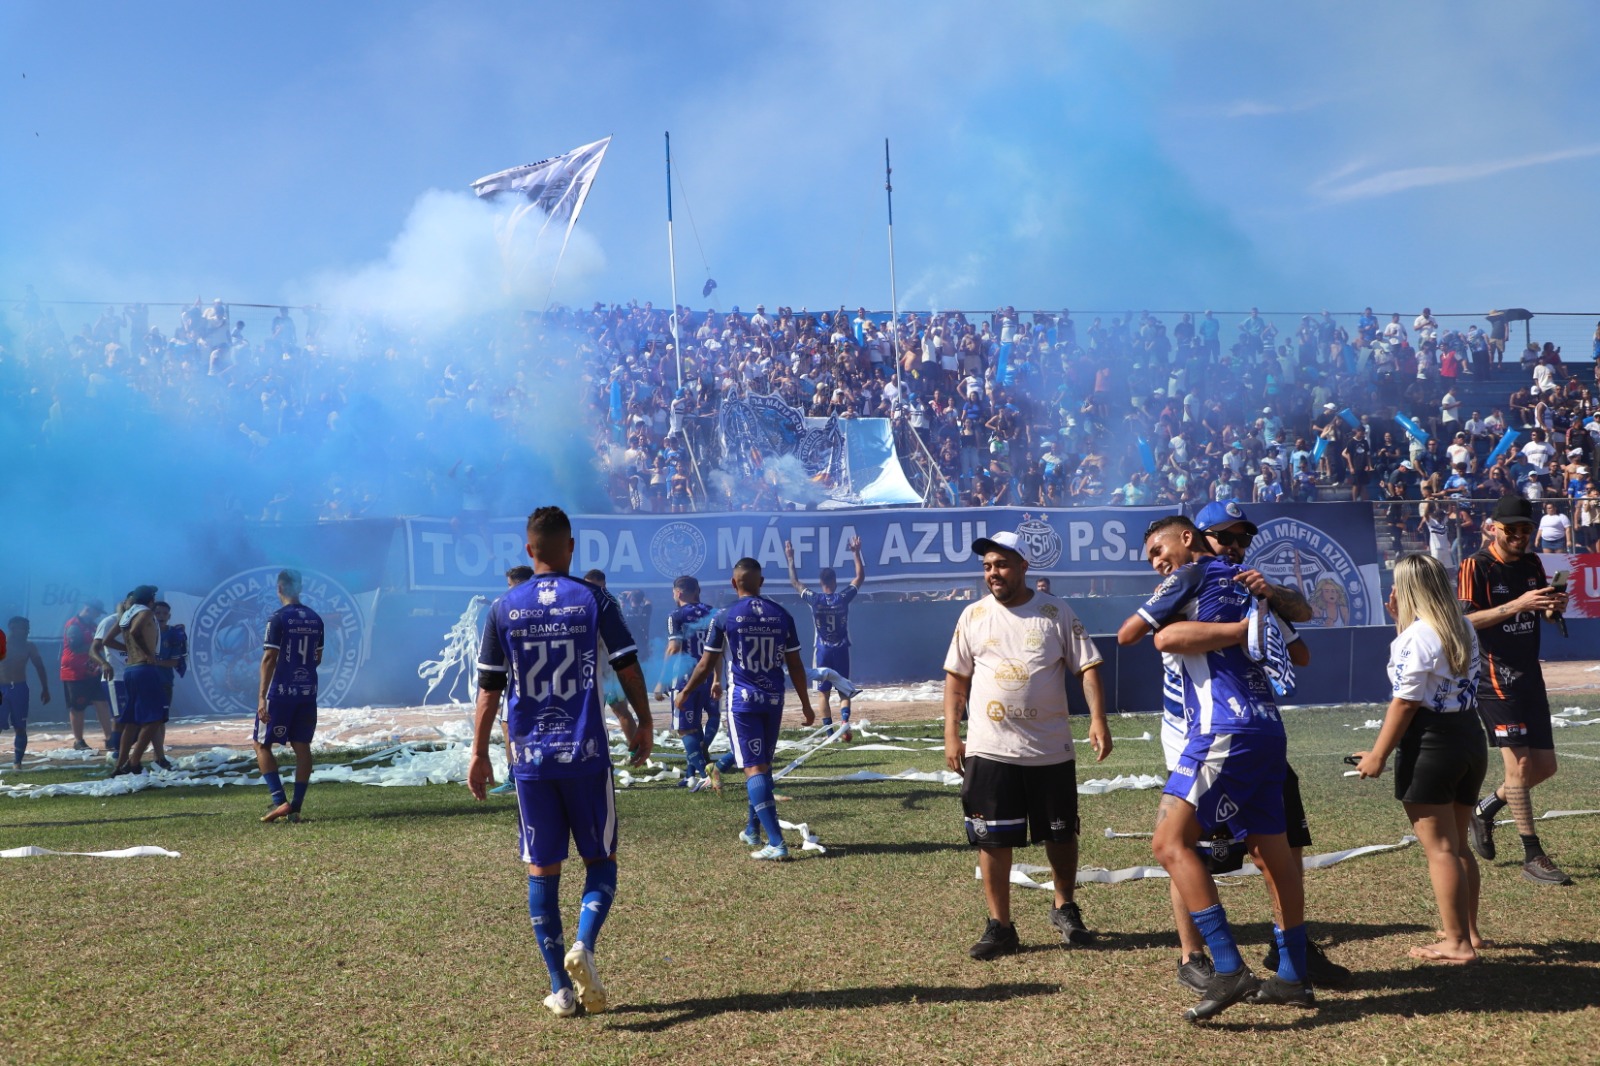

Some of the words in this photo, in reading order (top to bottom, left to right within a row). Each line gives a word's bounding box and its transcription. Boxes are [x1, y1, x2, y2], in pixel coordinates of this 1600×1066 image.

[717, 516, 865, 570] MÁFIA
[1321, 545, 1352, 580] AZUL
[196, 577, 262, 639] TORCIDA
[328, 597, 359, 639] AZUL
[826, 614, 836, 633] 9
[529, 622, 568, 634] BANCA
[297, 635, 309, 665] 4
[744, 636, 775, 674] 20
[523, 639, 578, 702] 22
[582, 649, 595, 690] WGS
[1007, 704, 1038, 718] Foco
[1214, 848, 1228, 856] PSA
